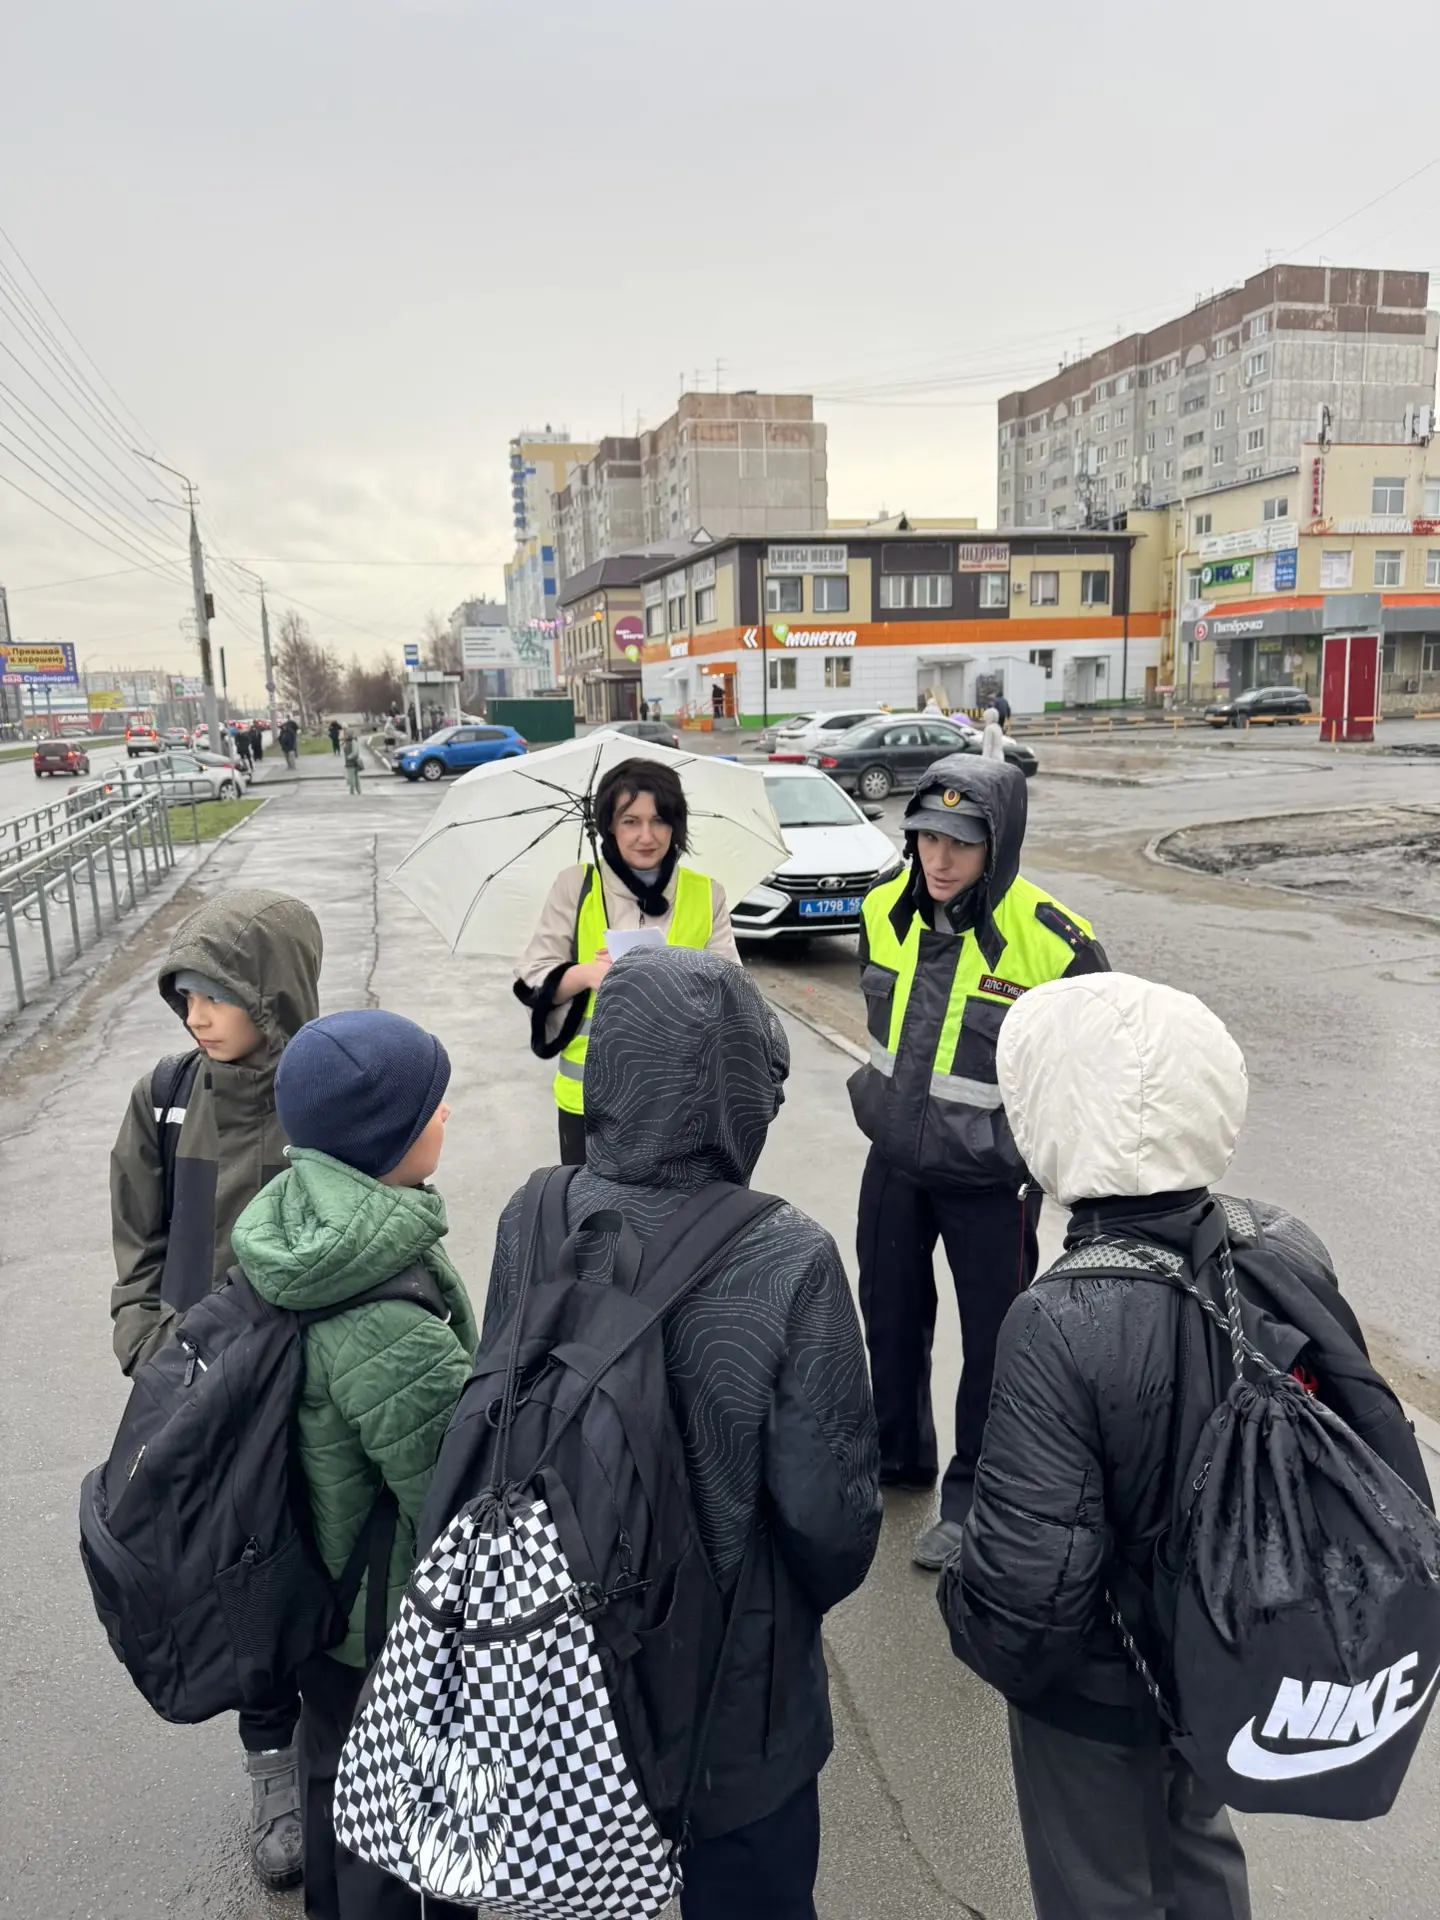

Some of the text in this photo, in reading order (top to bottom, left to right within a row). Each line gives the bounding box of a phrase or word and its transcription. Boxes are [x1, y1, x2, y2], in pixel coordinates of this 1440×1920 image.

[771, 548, 844, 563] ДЖИНСЫ ЮВЕЛИР
[961, 546, 1008, 561] ШТОРЫ
[12, 647, 60, 656] Привыкай
[18, 656, 64, 664] хорошему
[805, 898, 860, 913] А 1798 45
[984, 978, 1003, 990] ДПС
[1261, 1651, 1418, 1742] NIKE
